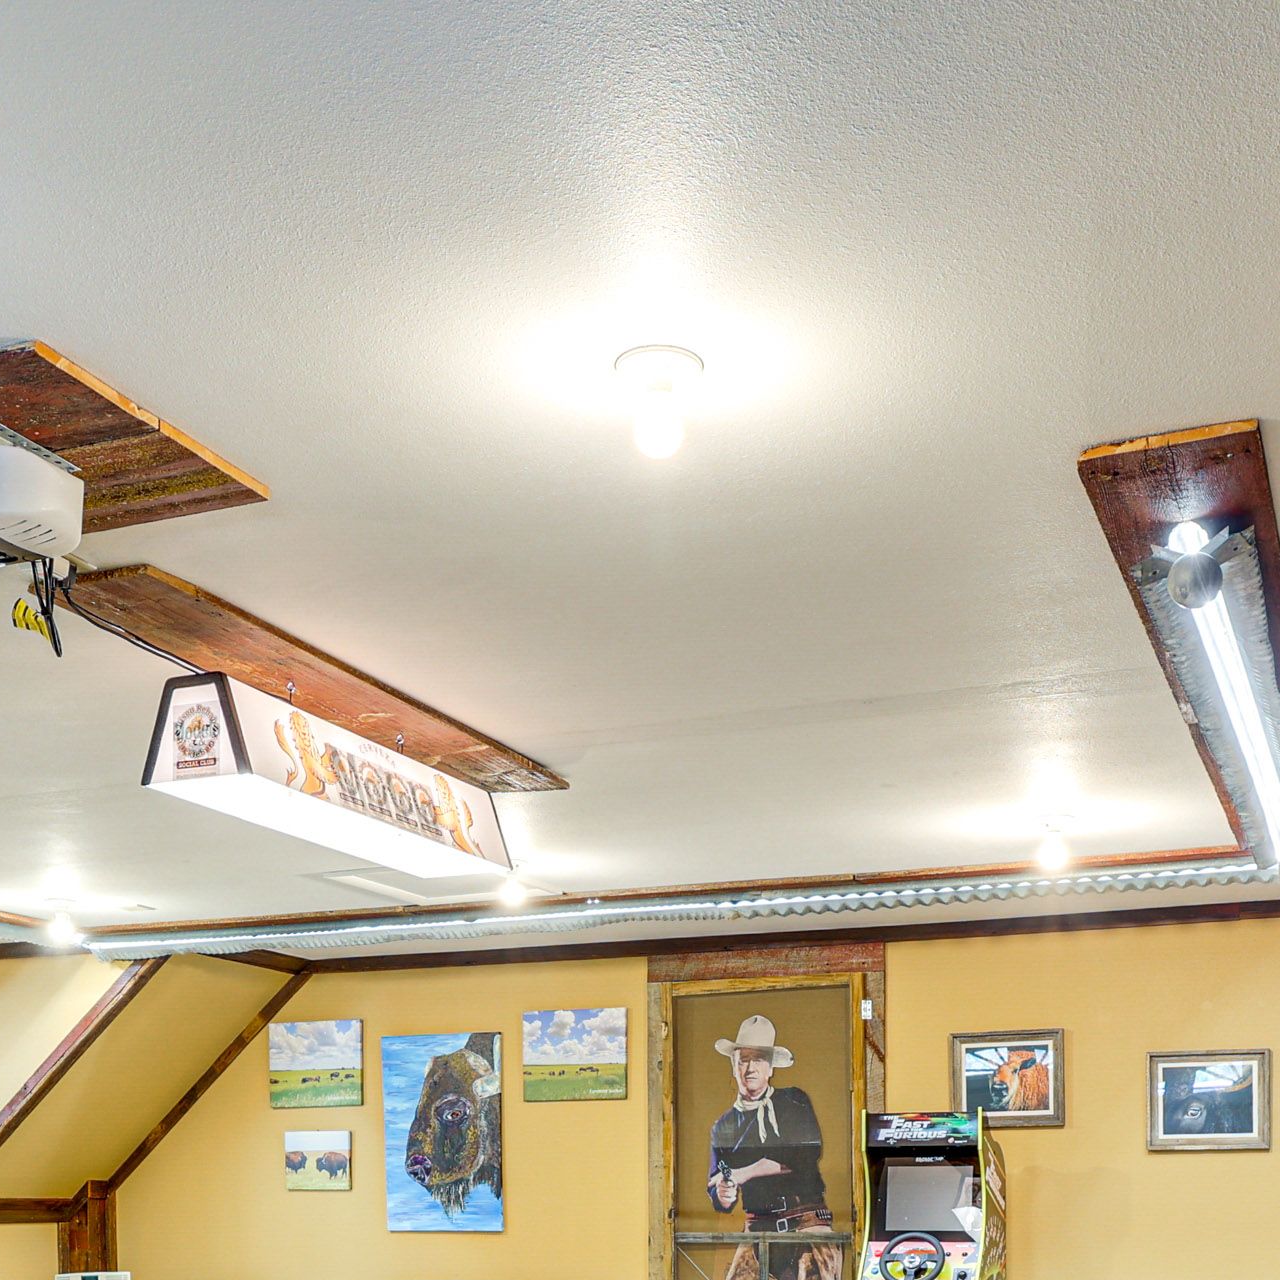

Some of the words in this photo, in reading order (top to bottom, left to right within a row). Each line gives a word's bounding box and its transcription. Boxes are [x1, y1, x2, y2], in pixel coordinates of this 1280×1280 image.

[178, 761, 199, 769] SOCIAL
[891, 1118, 931, 1128] FAST
[877, 1128, 948, 1141] FURIOUS
